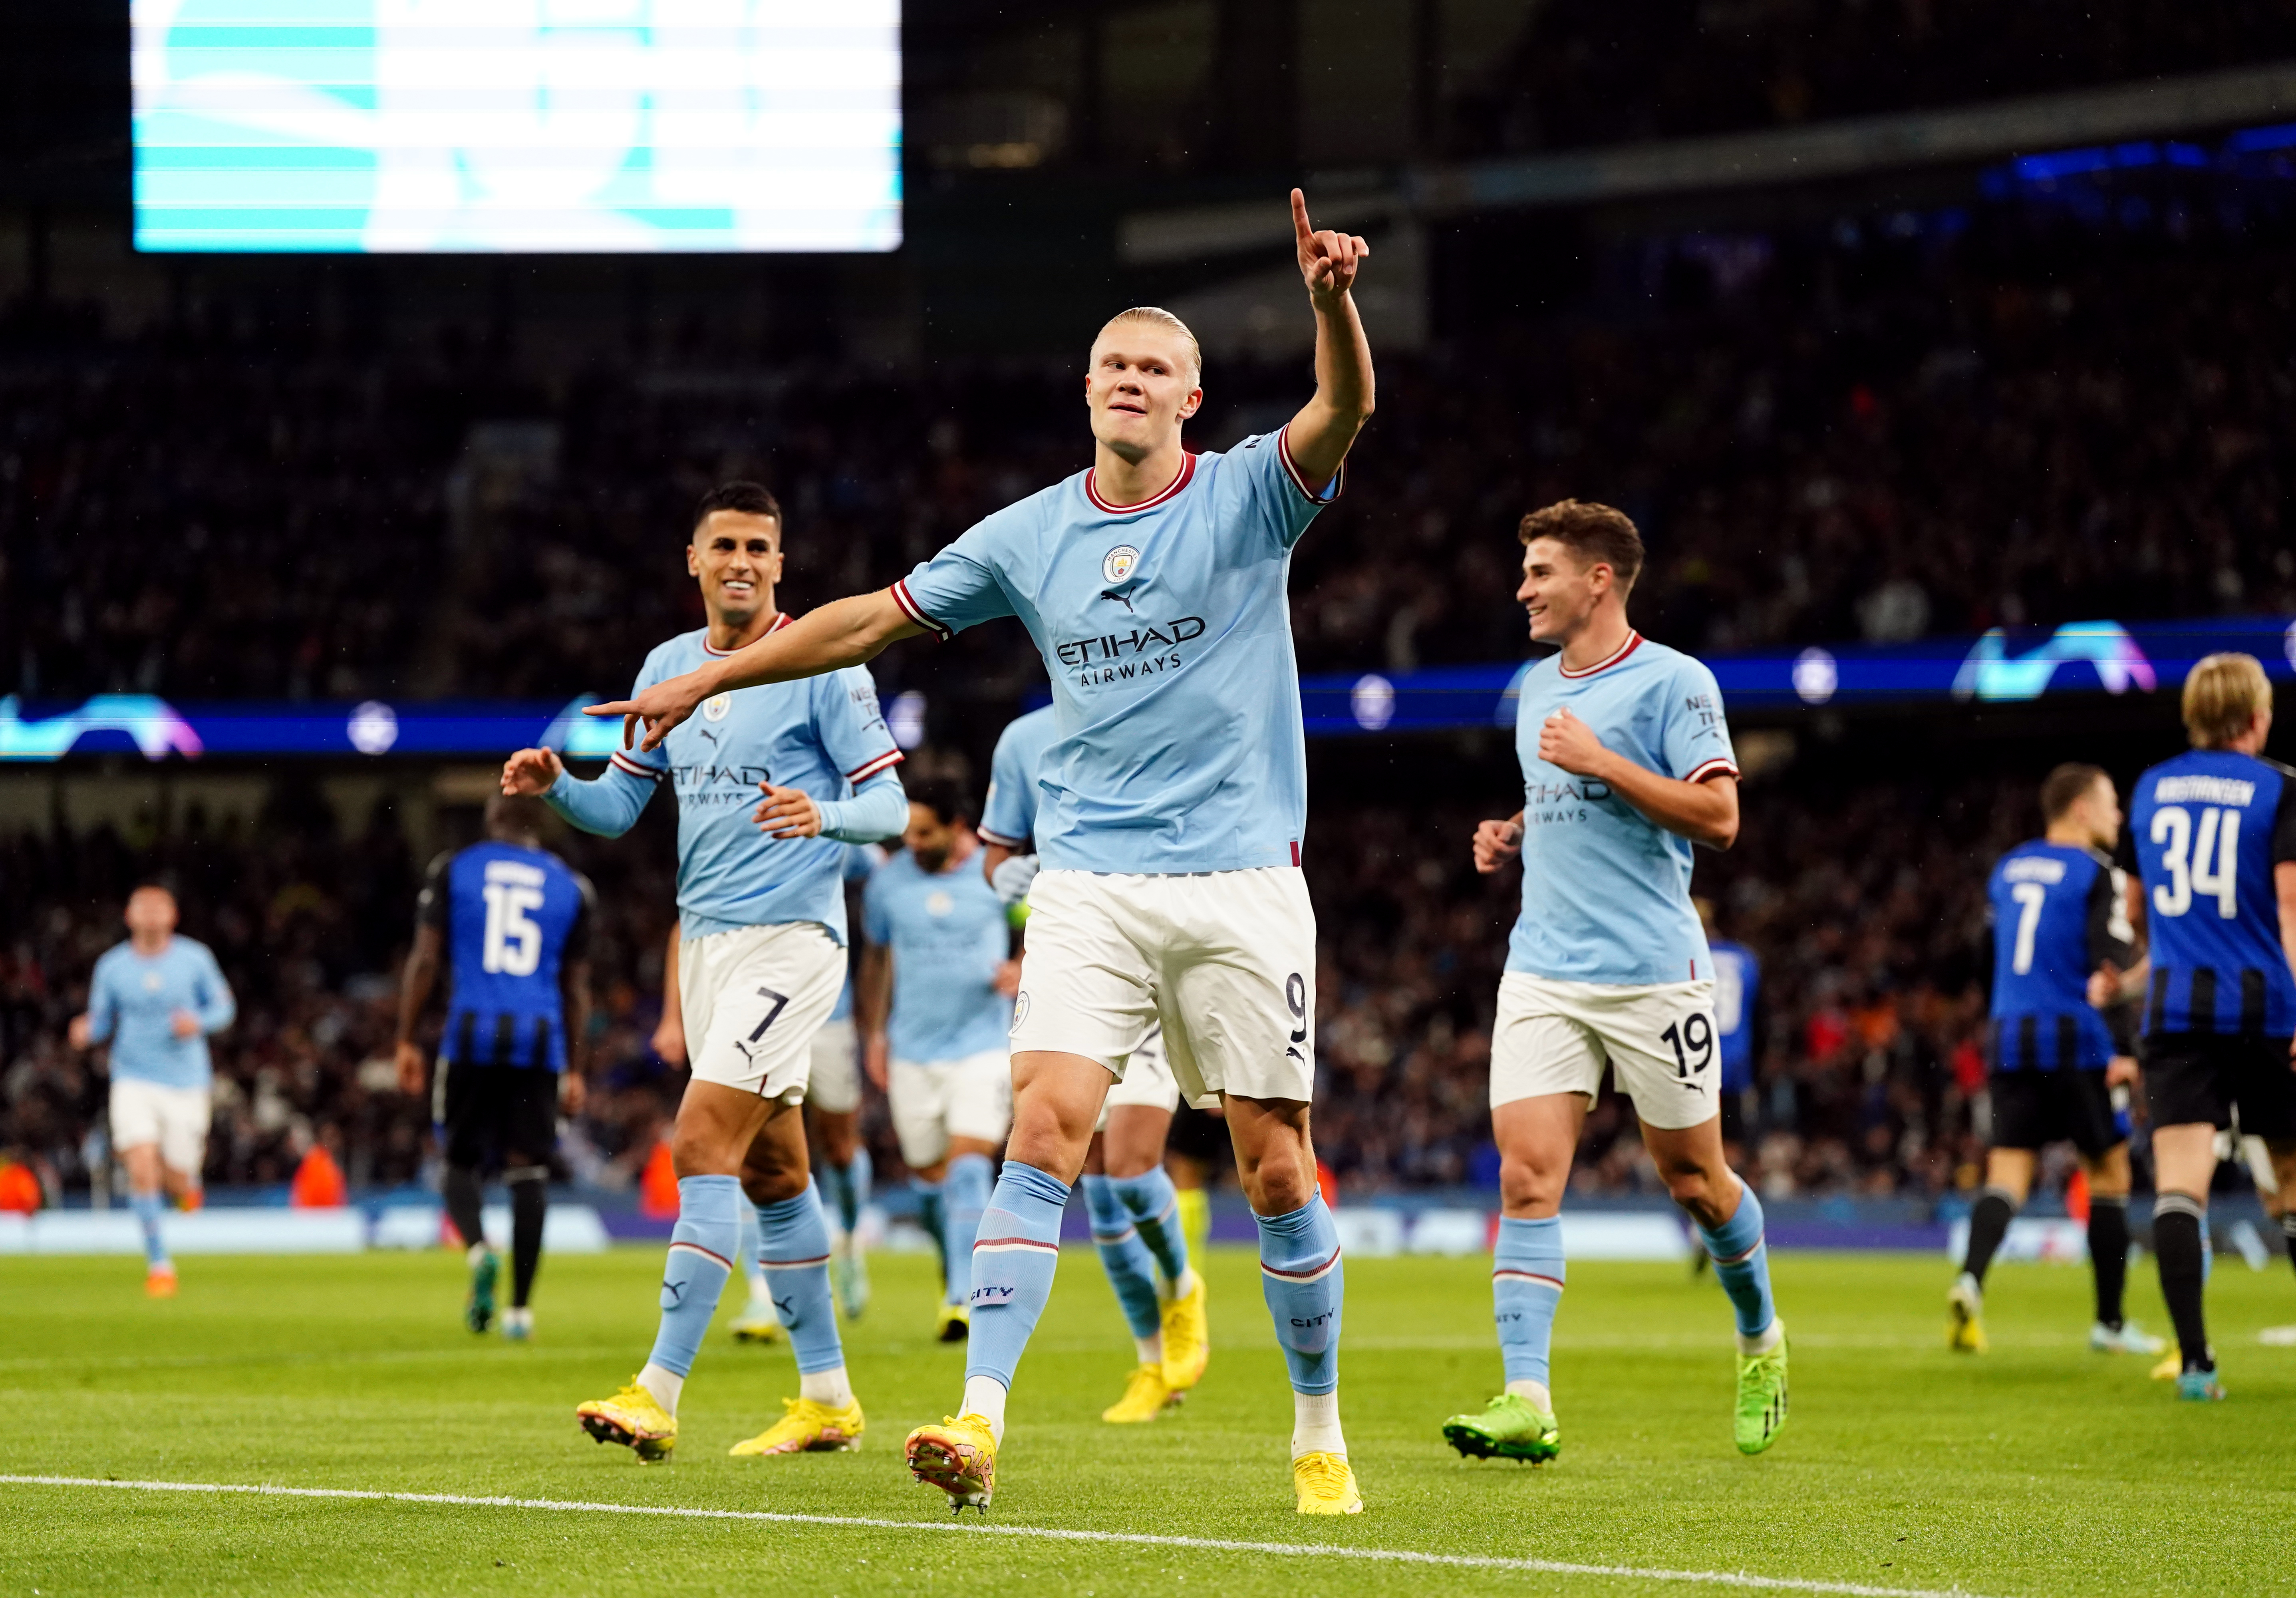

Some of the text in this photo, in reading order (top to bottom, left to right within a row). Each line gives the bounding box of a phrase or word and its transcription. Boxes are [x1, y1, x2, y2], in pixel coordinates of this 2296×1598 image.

[1107, 549, 1138, 561] MANCHESTER
[1057, 616, 1206, 666] ETIHAD
[1081, 653, 1181, 687] AIRWAYS
[1524, 781, 1610, 805] TIHAD
[2151, 807, 2241, 919] 34
[483, 884, 545, 977] 15
[2012, 882, 2045, 976] 7
[748, 987, 789, 1043] 7
[1286, 972, 1307, 1043] 9
[1661, 1013, 1712, 1077] 19
[971, 1287, 1013, 1301] CITY
[1291, 1307, 1334, 1327] CITY
